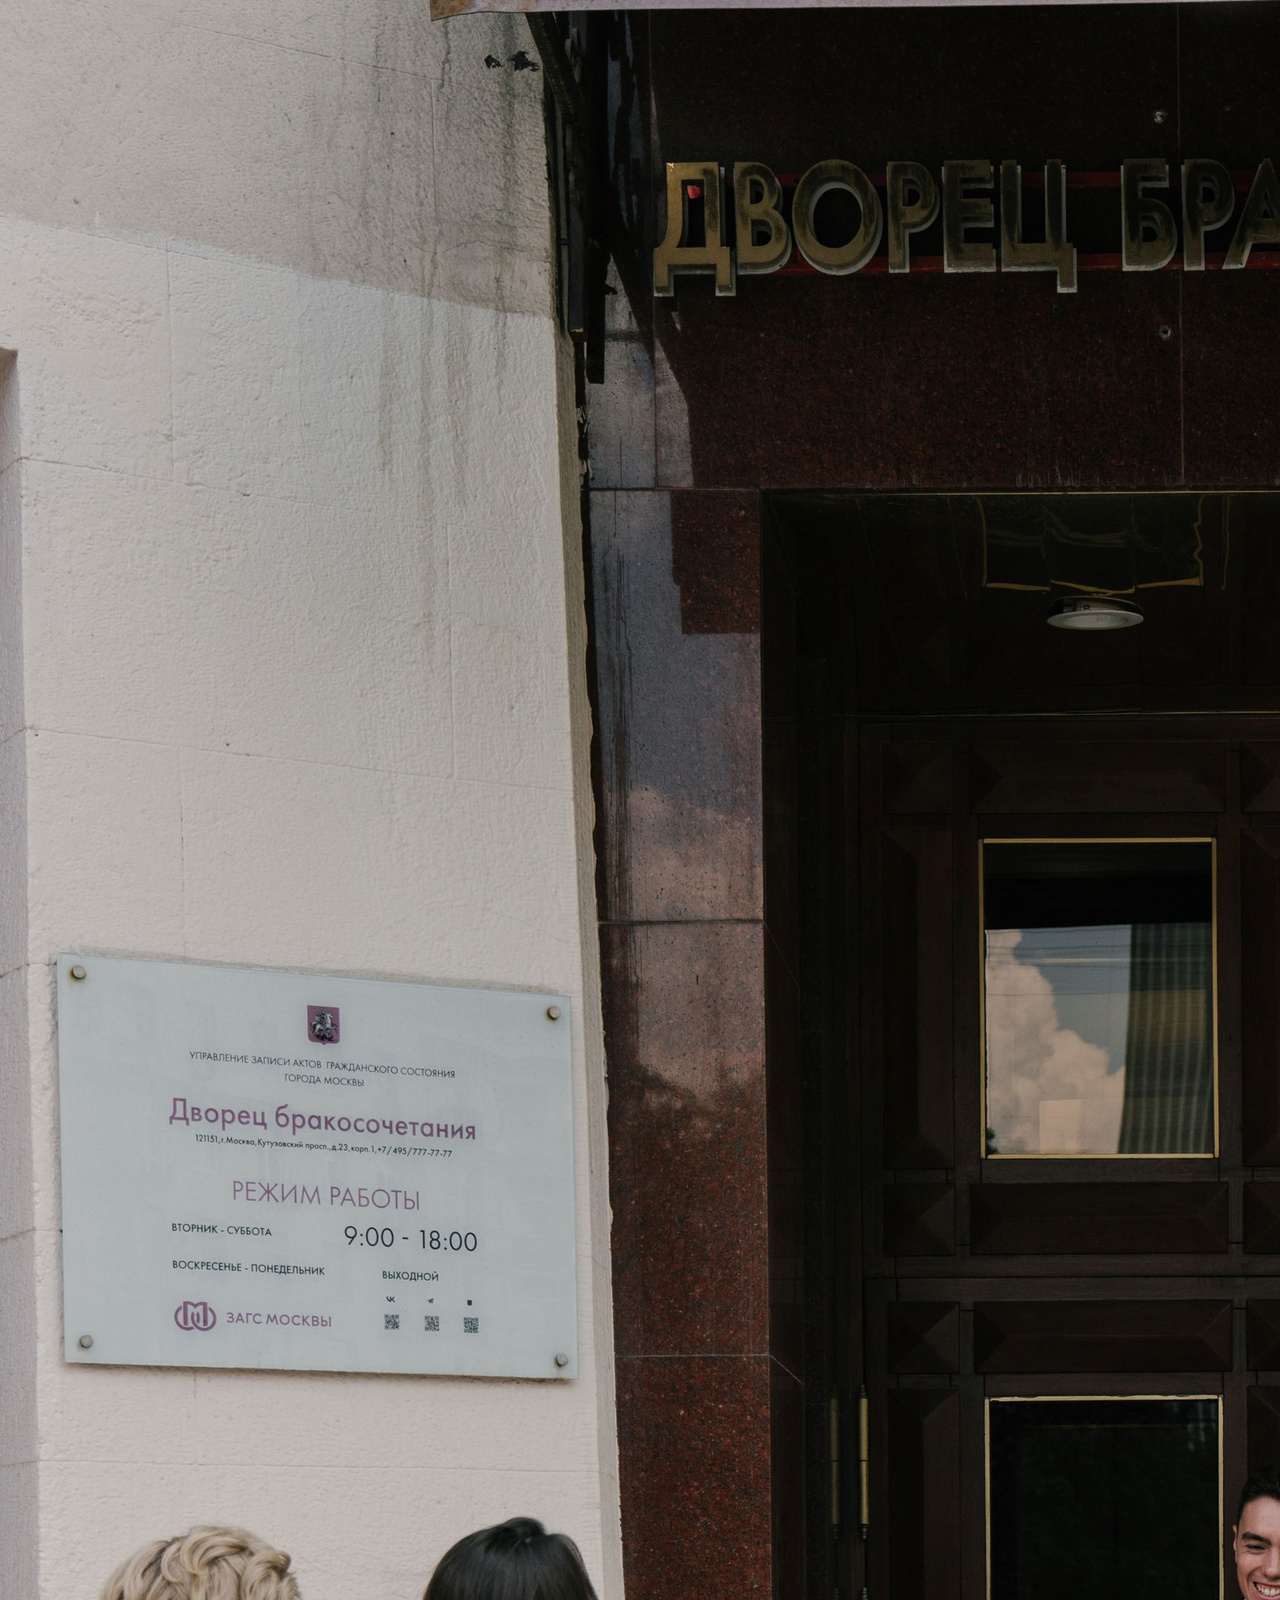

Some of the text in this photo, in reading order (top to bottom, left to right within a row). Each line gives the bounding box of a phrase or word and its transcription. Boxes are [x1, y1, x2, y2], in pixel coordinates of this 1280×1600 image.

[653, 160, 1077, 297] ДВОРЕЦ
[189, 1050, 456, 1079] УПРАВЛЕНИЕ ЗАПИСИ АКТОВ ГРАЖДАНСКОГО СОСТОЯНИЯ
[284, 1073, 365, 1087] ГОРОДА МОСКВЫ
[168, 1097, 476, 1141] Дворец бракосочетания
[232, 1180, 420, 1211] РЕЖИМ РАБОТЫ
[171, 1222, 219, 1234] ВТОРНИК
[226, 1225, 273, 1237] СУББОТА
[343, 1225, 395, 1248] 9:00
[419, 1229, 478, 1253] 18:00
[172, 1259, 243, 1272] ВОСКРЕСЕНЬЕ
[250, 1263, 326, 1276] ПОНЕДЕЛЬНИК
[381, 1270, 439, 1283] ВЫХОДНОЙ
[226, 1311, 332, 1328] ЗАГС МОСКВЫ
